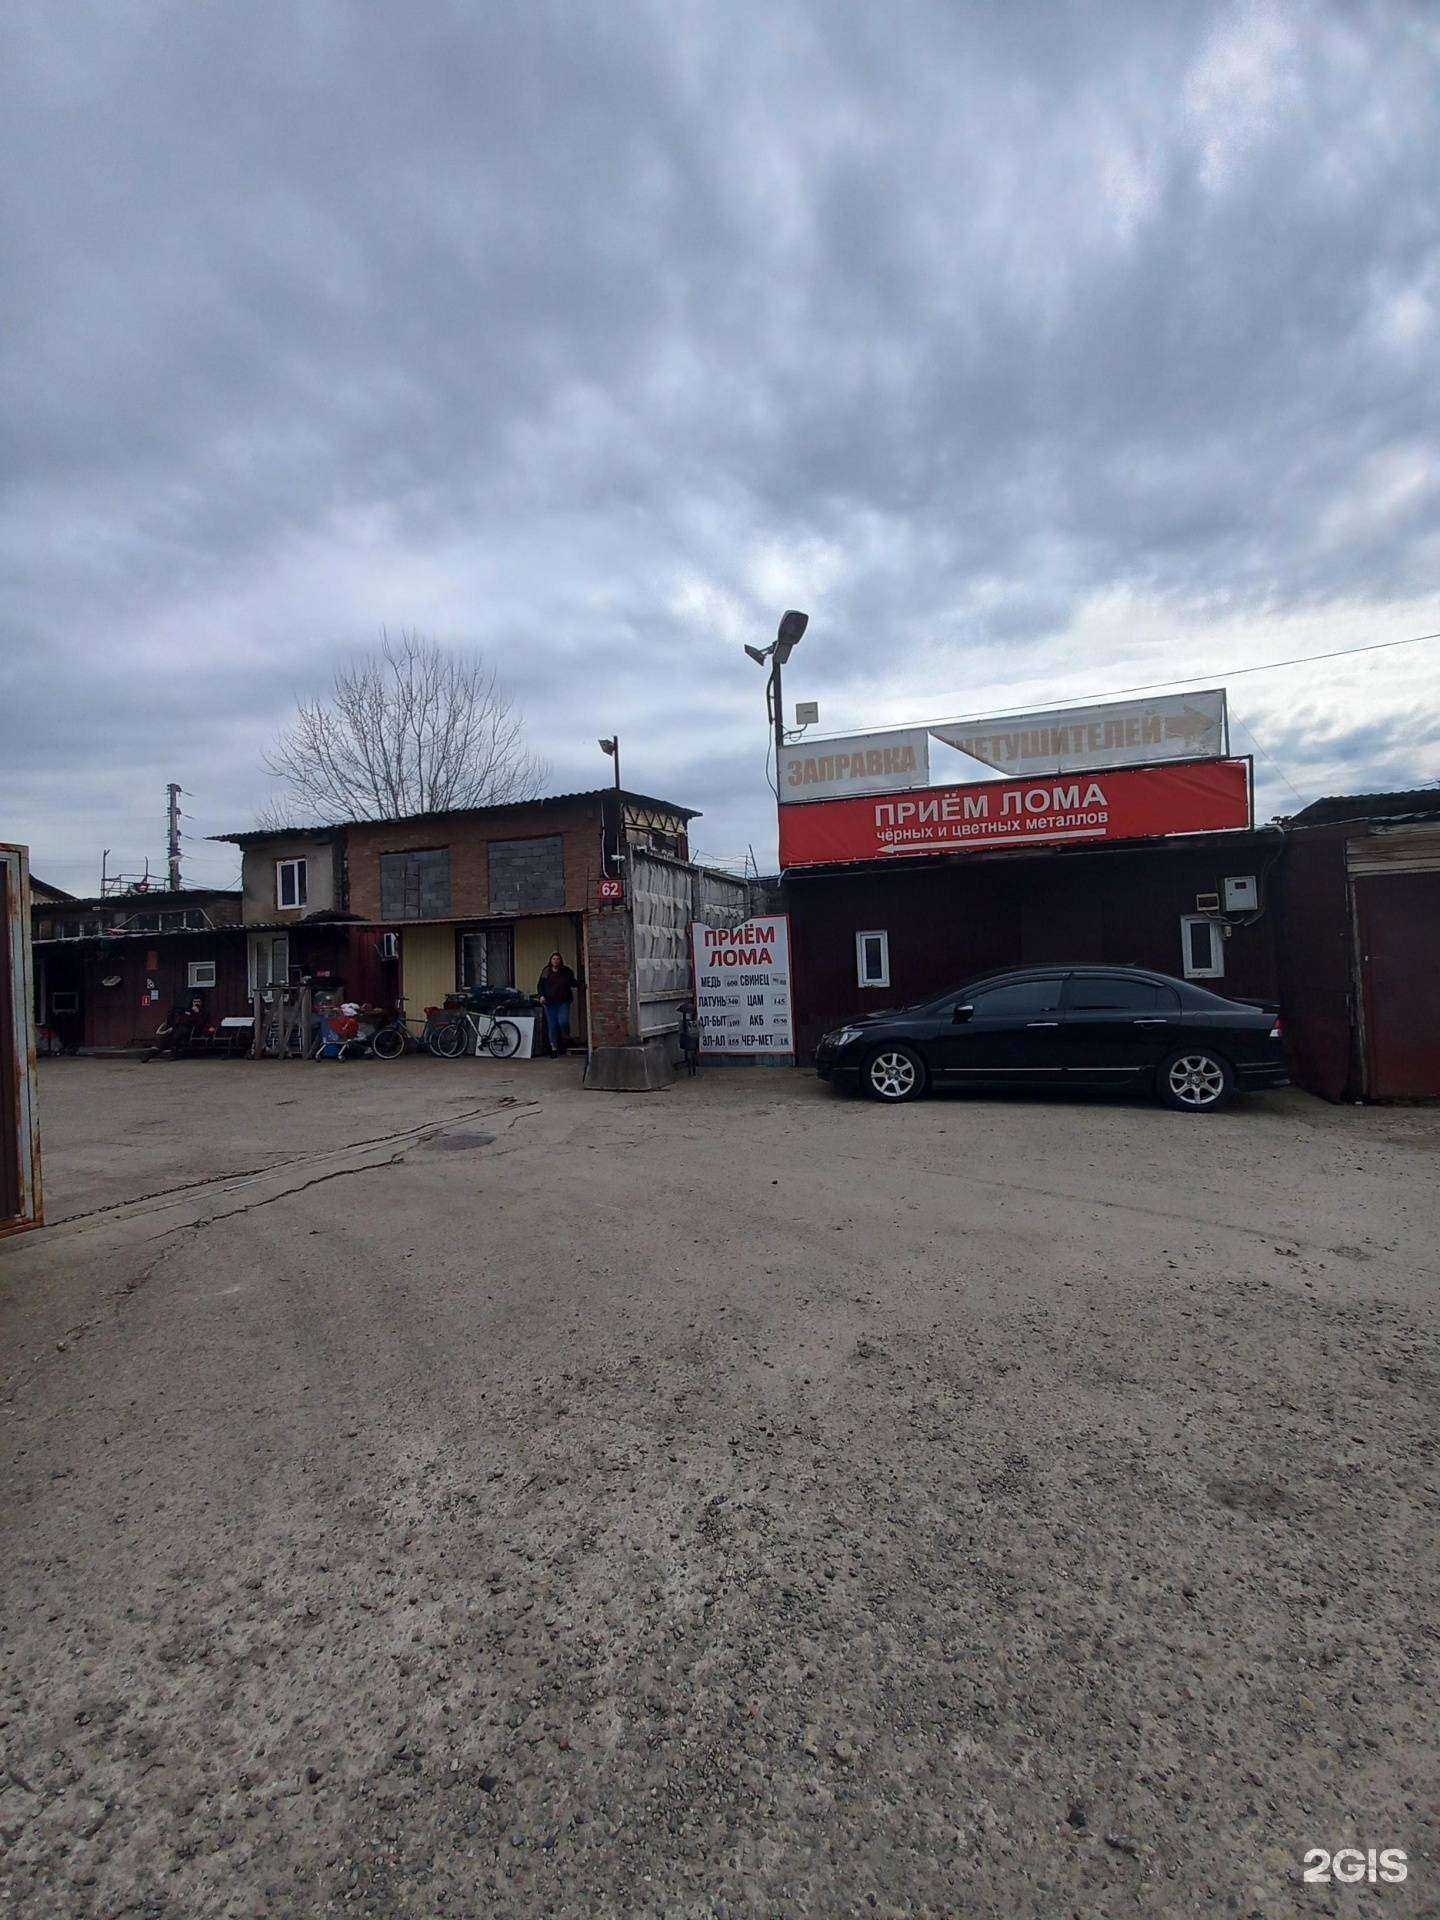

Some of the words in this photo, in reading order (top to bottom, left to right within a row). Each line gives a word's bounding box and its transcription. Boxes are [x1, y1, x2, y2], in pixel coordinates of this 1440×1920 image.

[787, 746, 917, 786] ЗАПРАВКА
[875, 793, 989, 827] ПРИЁМ
[1000, 783, 1109, 816] ЛОМА
[876, 827, 933, 843] чёрных
[938, 829, 947, 837] и
[952, 820, 1020, 836] цветных
[1026, 811, 1109, 830] металлов
[602, 882, 619, 896] 62
[705, 924, 775, 946] ПРИЁМ
[709, 947, 773, 967] ЛОМА
[701, 976, 722, 988] МЕДЬ
[740, 974, 770, 986] СВИНЕЦ
[747, 994, 764, 1006] ЦАМ
[750, 1014, 764, 1026] АКБ
[741, 1034, 774, 1046] ЧЕР-МЕТ
